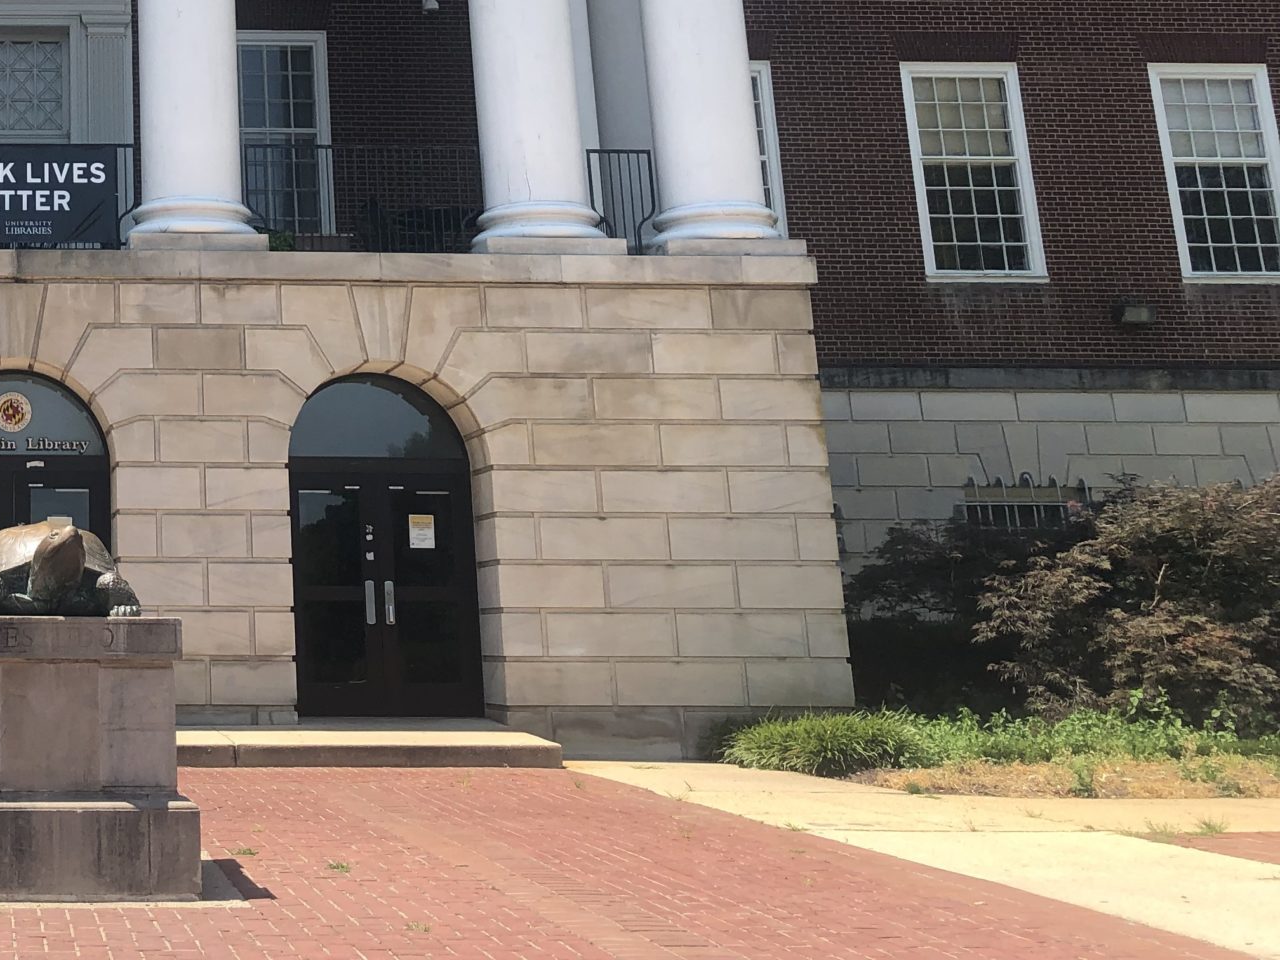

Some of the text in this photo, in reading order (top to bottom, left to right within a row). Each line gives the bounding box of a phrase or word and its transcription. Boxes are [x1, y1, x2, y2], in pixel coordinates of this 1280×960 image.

[26, 162, 107, 184] LIVES
[5, 227, 52, 235] LIBRARIES
[26, 436, 90, 454] Library
